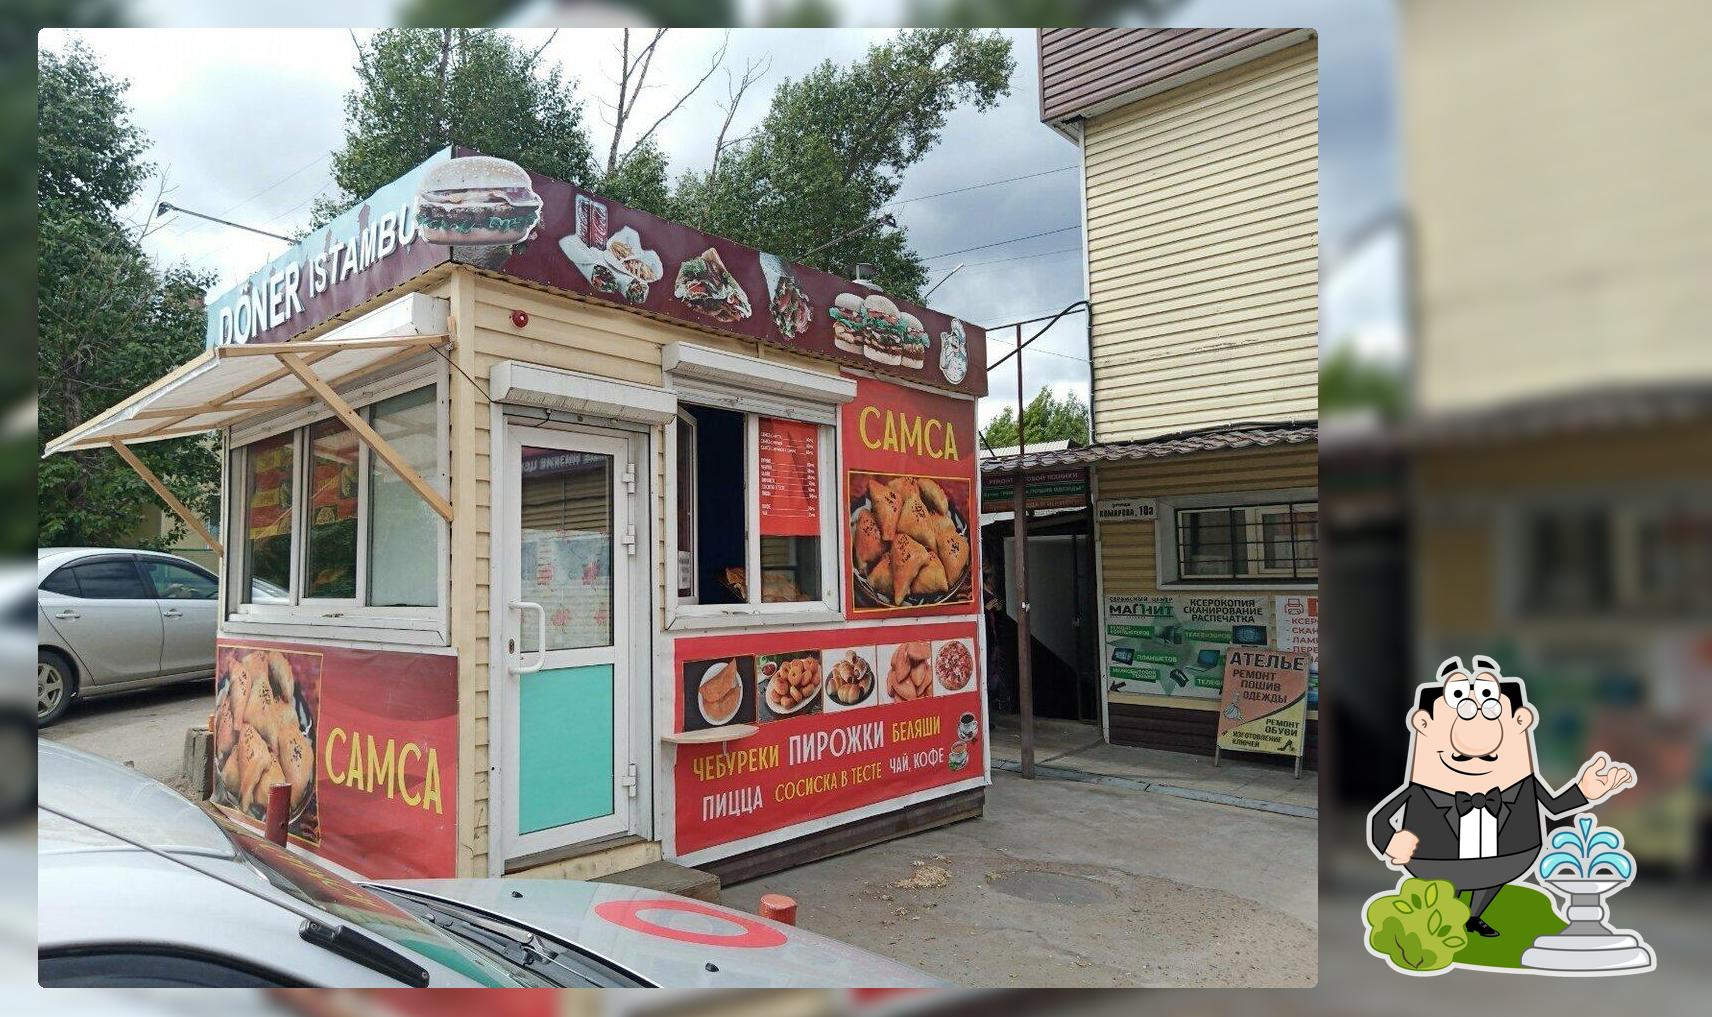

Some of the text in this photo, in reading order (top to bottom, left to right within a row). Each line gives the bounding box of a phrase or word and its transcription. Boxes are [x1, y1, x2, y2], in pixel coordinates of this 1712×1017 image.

[217, 203, 420, 347] DÖNER ISTAMBU
[859, 405, 959, 462] САМСА
[1190, 599, 1256, 608] КСЕРОКОПИЯ
[1183, 606, 1263, 616] СКАНИРОВАНИЕ
[1191, 614, 1255, 623] РАСПЕЧАТКА
[1230, 652, 1305, 671] АТЕЛЬЕ
[1232, 669, 1277, 681] РЕМОНТ
[1240, 680, 1282, 692] ПОШИВ
[1242, 691, 1288, 704] ОДЕЖДЫ
[1266, 718, 1300, 728] РЕМОНТ
[1232, 731, 1282, 743] ИЗГОТОВЛЕНИЕ
[1264, 726, 1298, 736] ОБУВИ
[693, 715, 941, 782] ЧЕБУРЕКИ ПИРОЖКИ БЕЛЯШИ
[1232, 738, 1260, 748] КЛЮЧЕЙ
[325, 727, 443, 815] САМСА
[702, 747, 945, 822] ПИЦЦА СОСИСКА В ТЕСТЕ ЧАЙ, КОФЕ
